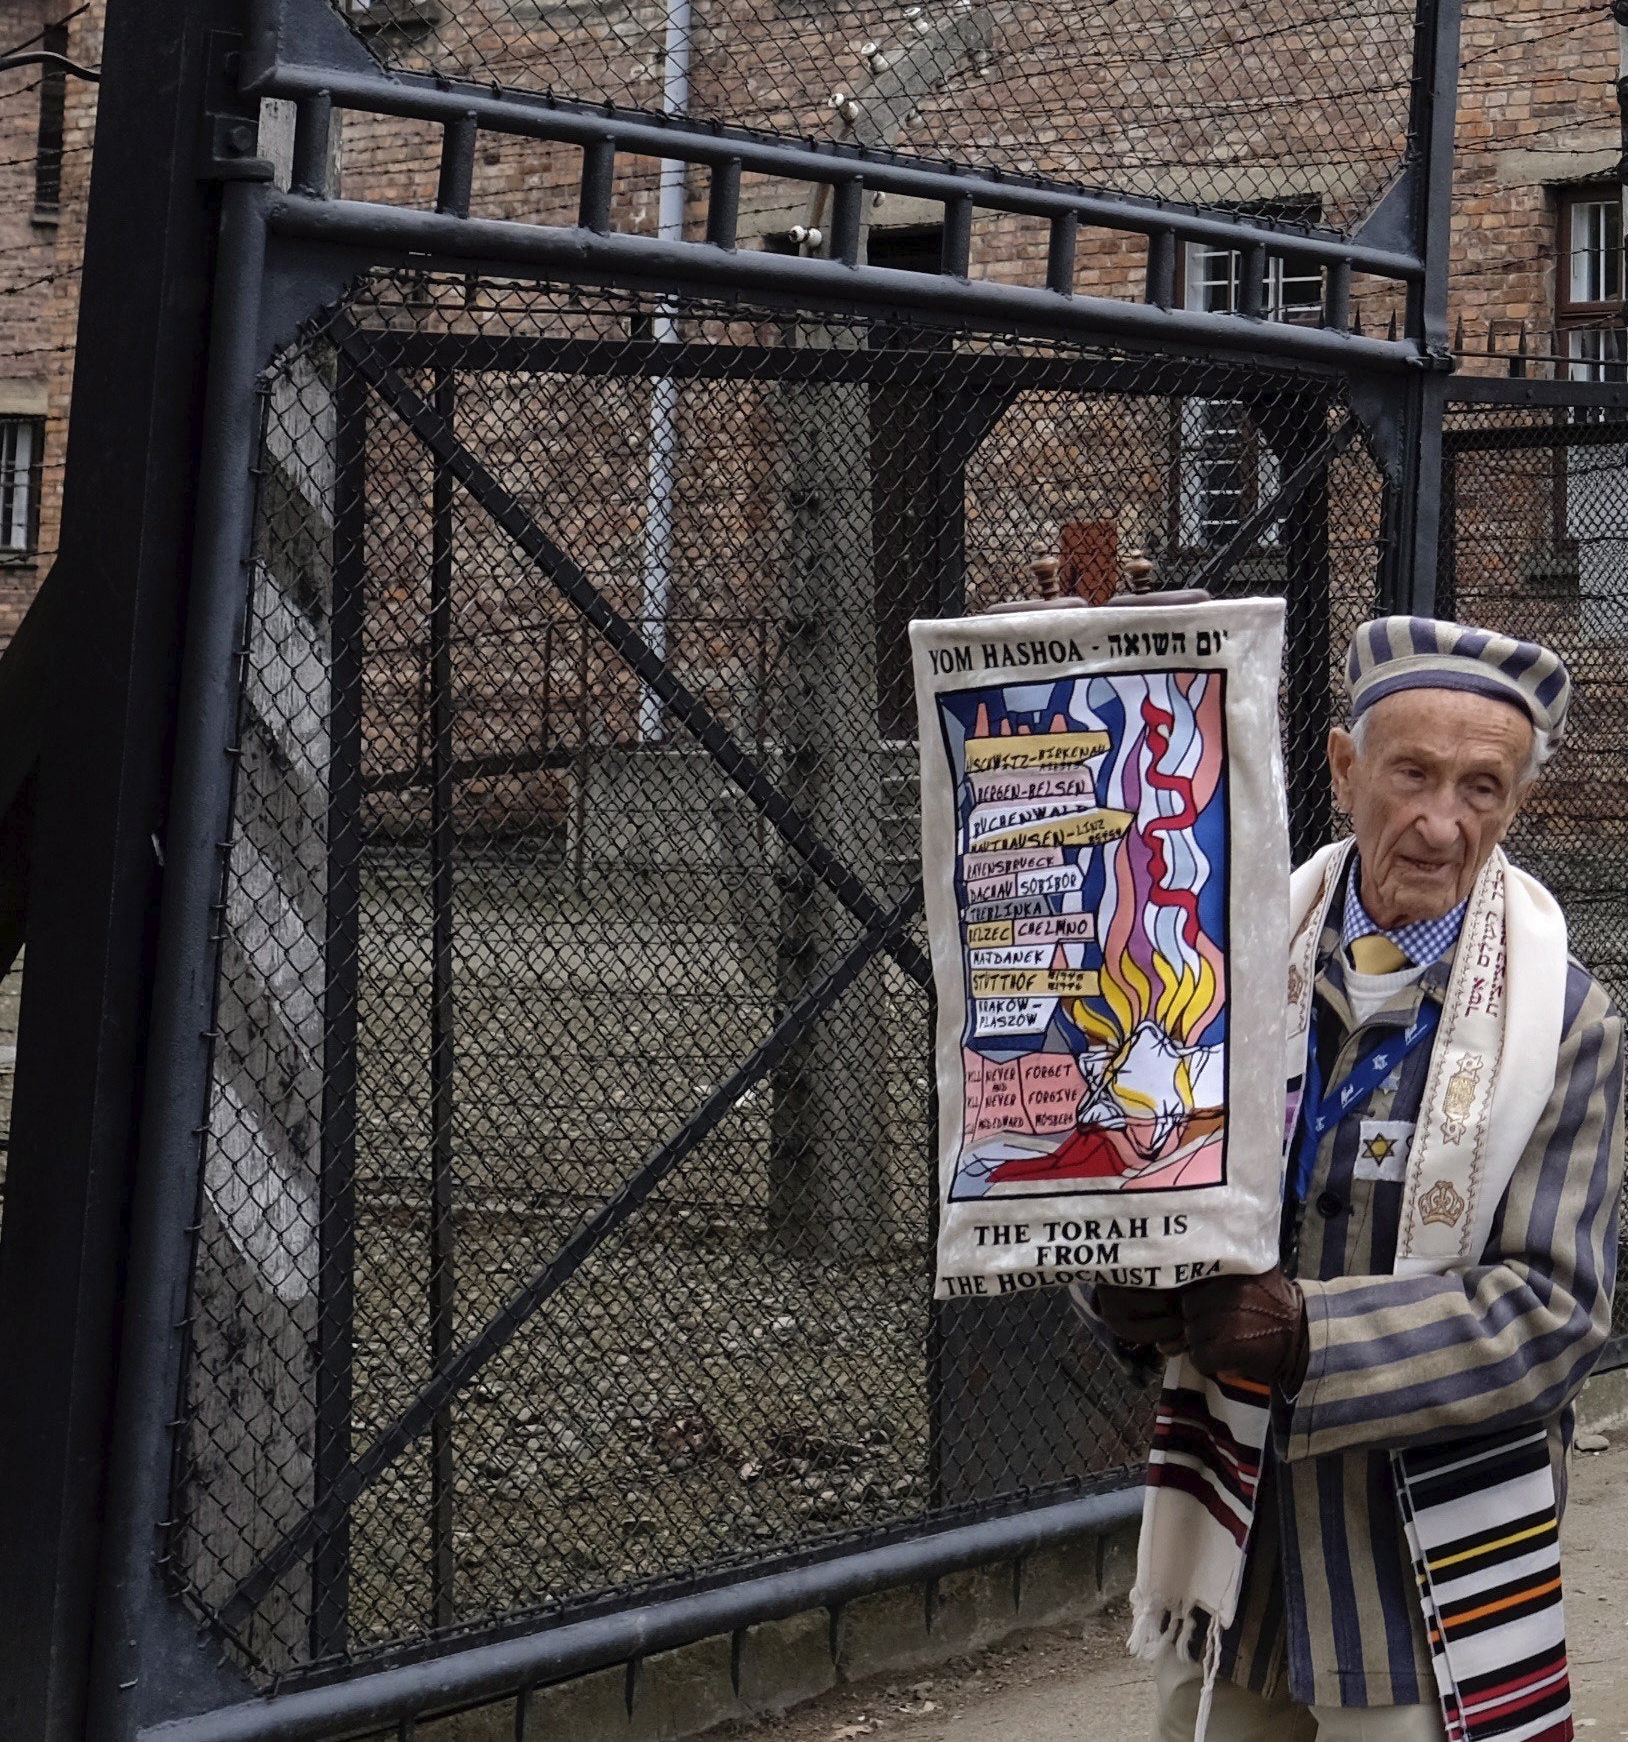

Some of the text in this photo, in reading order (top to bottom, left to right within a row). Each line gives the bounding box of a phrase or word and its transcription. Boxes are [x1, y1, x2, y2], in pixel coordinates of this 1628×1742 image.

[1108, 631, 1186, 657] השואה
[928, 646, 973, 675] YOM
[981, 639, 1085, 669] HASHOA
[970, 881, 1013, 902] DACHAU
[1020, 873, 1077, 895] SOBIBOR
[1018, 919, 1088, 936] CHELMNO
[973, 950, 1044, 965] MAJDANEK
[973, 972, 1037, 991] STUTTHOF
[985, 1067, 1016, 1083] NEVER
[1025, 1063, 1073, 1080] FORGET
[985, 1093, 1016, 1109] NEVER
[1028, 1089, 1077, 1105] FORGIVE
[974, 1215, 1187, 1246] THE TORAH IS
[1036, 1243, 1119, 1267] FROM
[942, 1259, 1224, 1296] THE HOLOCAUST ERA
